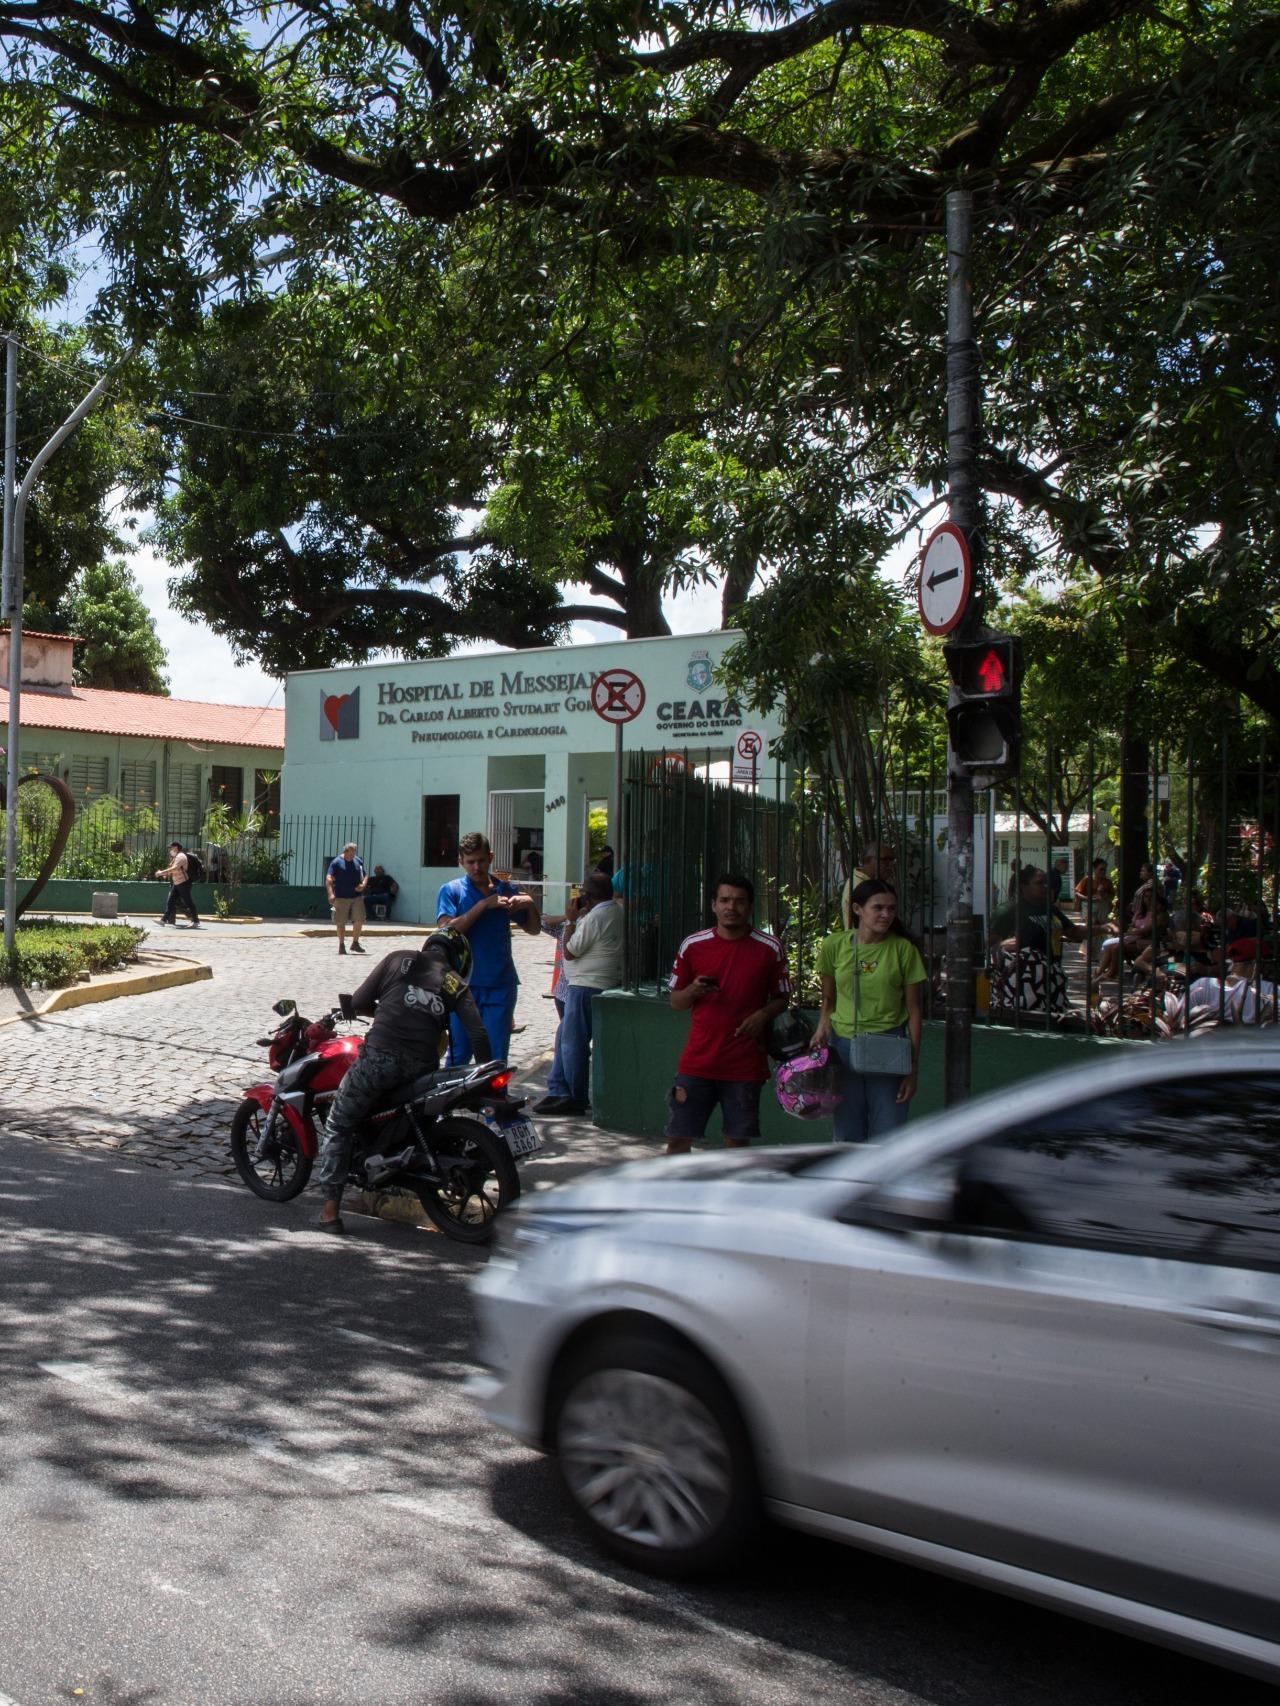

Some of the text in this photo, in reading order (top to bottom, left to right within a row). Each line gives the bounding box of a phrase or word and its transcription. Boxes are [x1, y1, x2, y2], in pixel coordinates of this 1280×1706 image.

[377, 671, 606, 705] HOSPITAL DE MESSEJAN
[400, 708, 444, 723] CARLOS
[447, 706, 500, 721] ALBERTO
[503, 701, 561, 717] STUDART
[656, 718, 743, 731] GOVERNO DO ESTADO
[513, 1135, 537, 1153] 3A67
